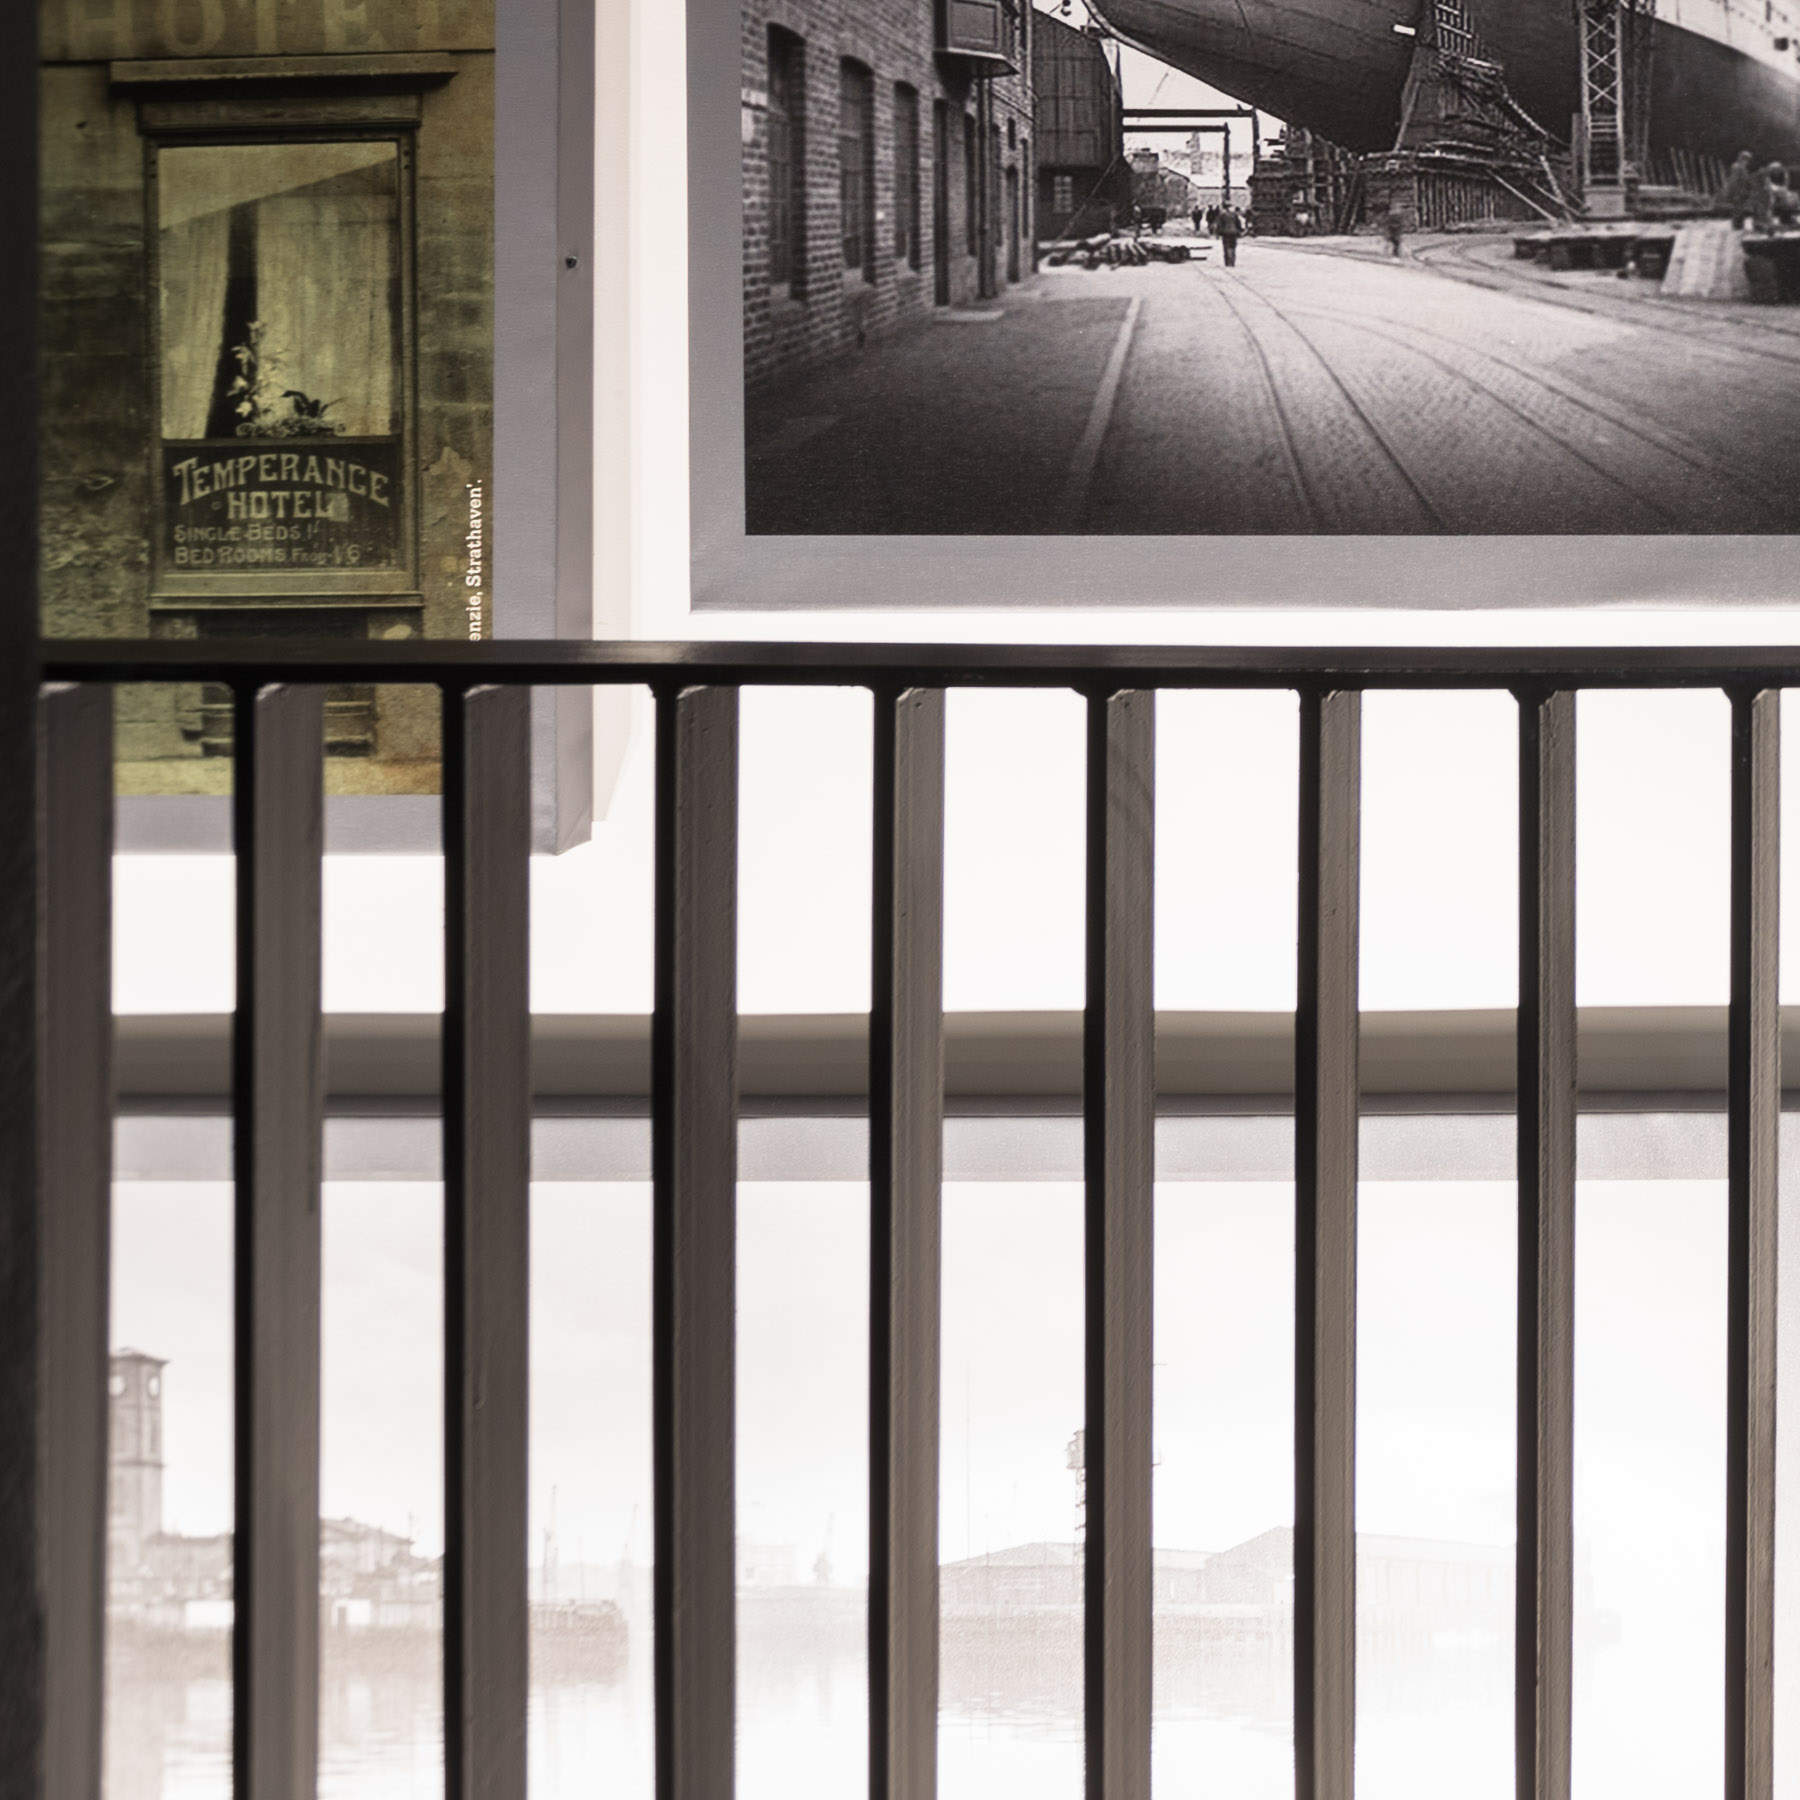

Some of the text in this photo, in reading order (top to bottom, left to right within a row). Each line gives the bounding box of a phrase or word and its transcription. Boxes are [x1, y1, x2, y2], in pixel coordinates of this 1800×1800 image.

[172, 453, 390, 507] TEMPERANCE
[226, 491, 336, 520] HOTEL
[173, 524, 242, 542] SINGLE
[247, 521, 301, 541] BEDS
